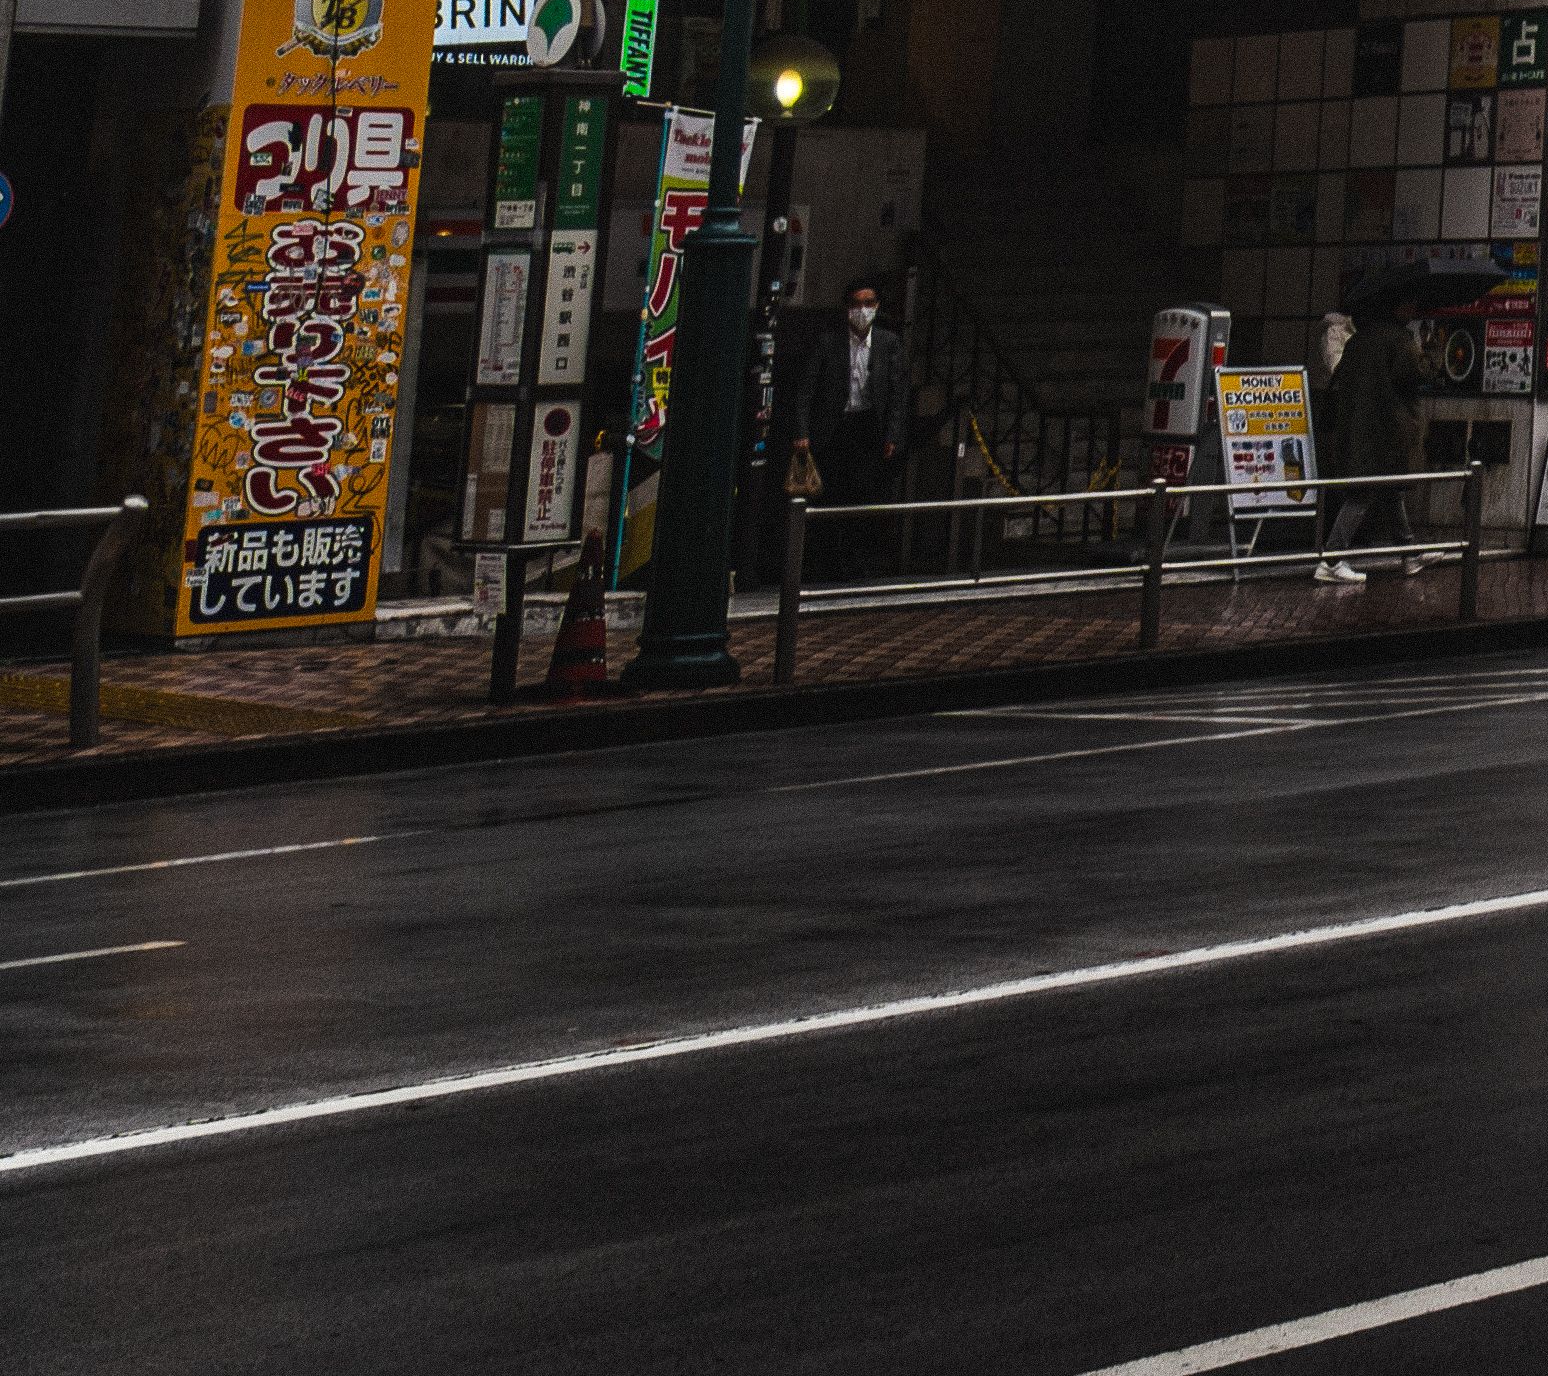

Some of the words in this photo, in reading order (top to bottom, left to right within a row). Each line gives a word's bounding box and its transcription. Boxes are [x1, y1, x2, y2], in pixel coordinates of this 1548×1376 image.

[457, 51, 487, 66] SELL
[626, 5, 654, 89] TIFFANY
[1511, 19, 1539, 66] 占
[245, 110, 406, 208] つり具
[571, 99, 594, 198] 神南一丁目
[554, 264, 576, 371] 渋谷駅西口
[1225, 390, 1302, 405] EXCHANGE
[1241, 375, 1283, 388] MONEY
[535, 438, 558, 522] 駐停車禁止
[204, 523, 366, 575] 新品も販売
[199, 567, 361, 616] しています
